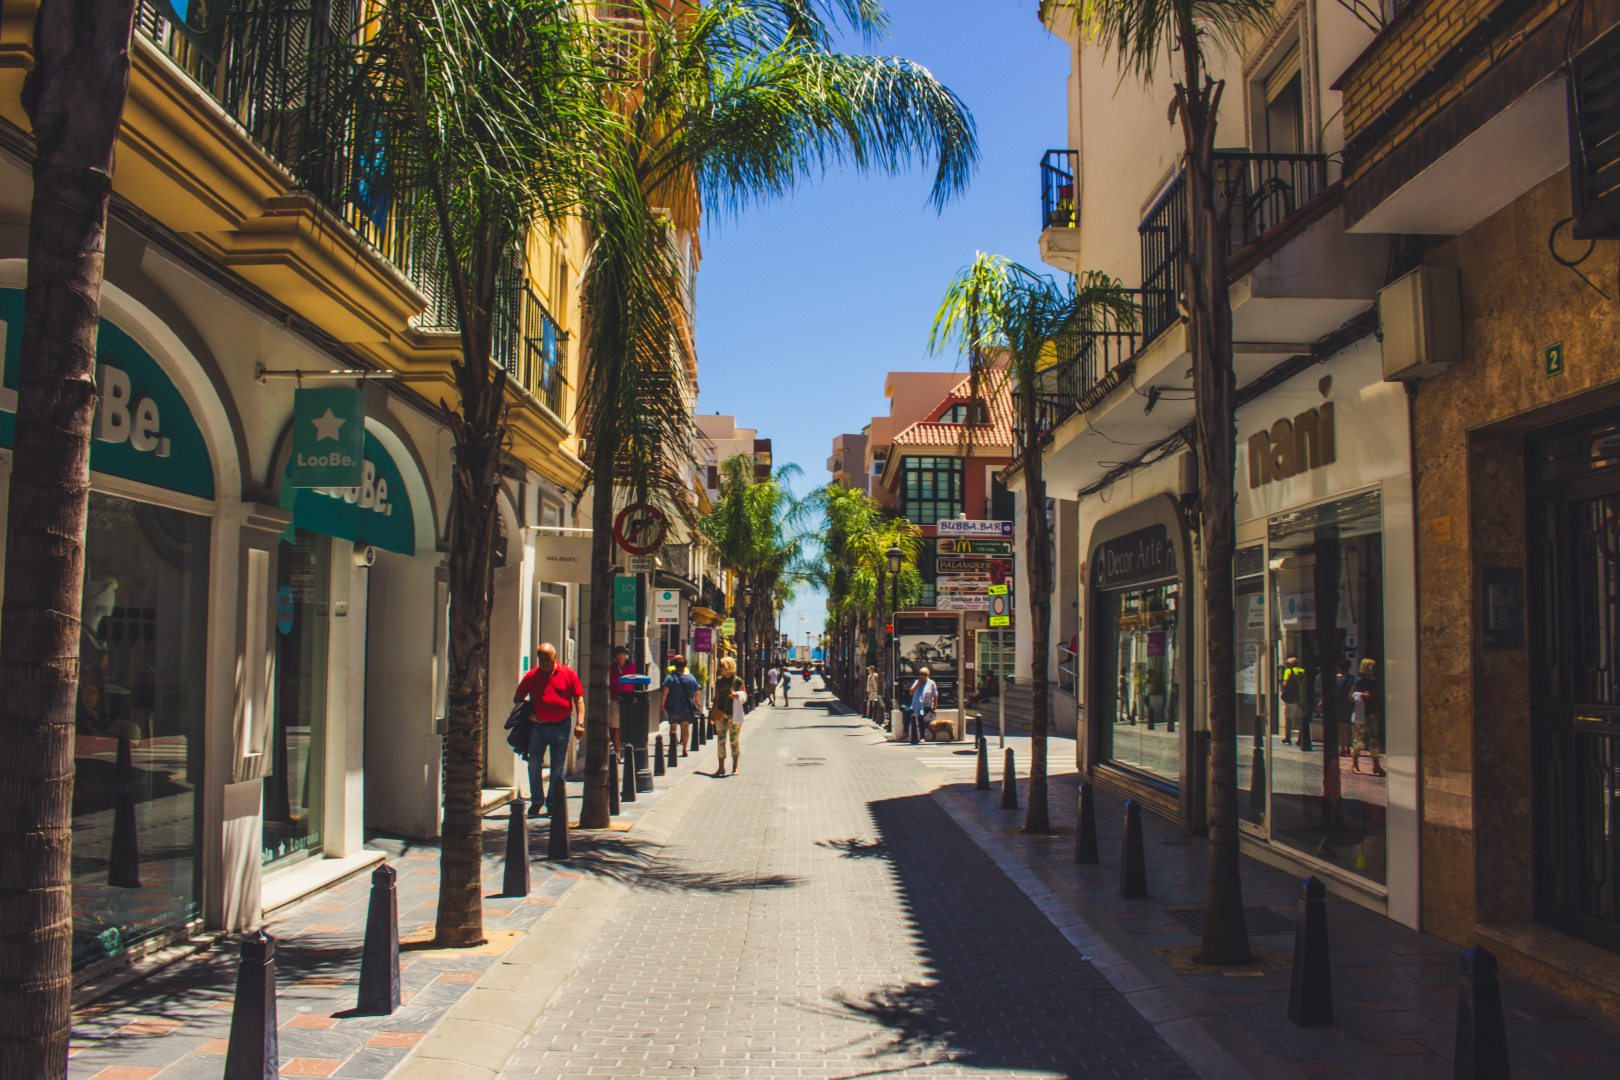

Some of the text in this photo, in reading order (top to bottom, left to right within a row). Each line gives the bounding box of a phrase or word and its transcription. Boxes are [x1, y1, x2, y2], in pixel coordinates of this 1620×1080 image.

[1550, 350, 1558, 370] 2
[1248, 375, 1336, 489] nani
[297, 452, 357, 467] LooBe.
[1107, 538, 1162, 577] Decor Arte
